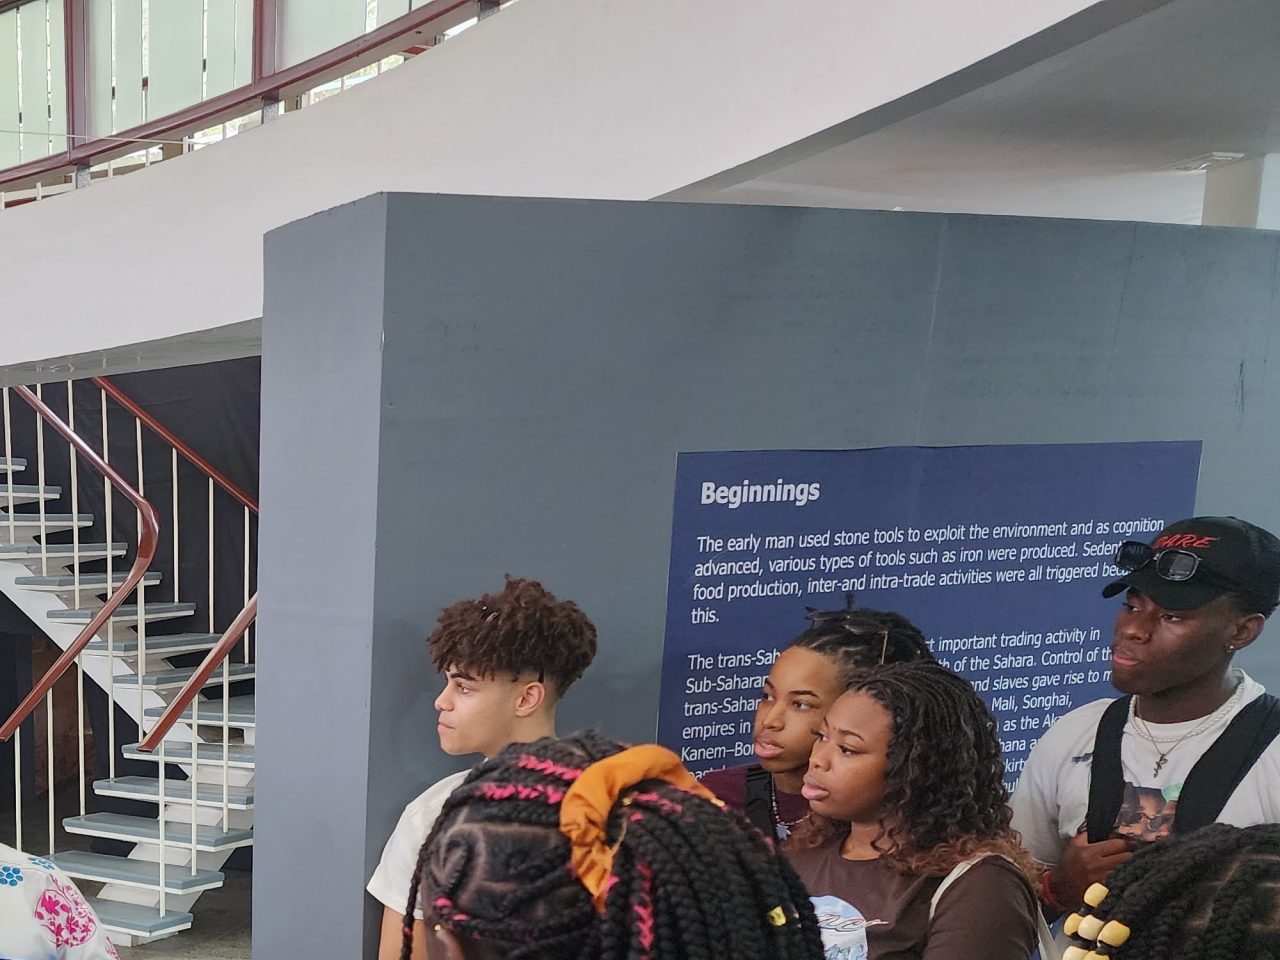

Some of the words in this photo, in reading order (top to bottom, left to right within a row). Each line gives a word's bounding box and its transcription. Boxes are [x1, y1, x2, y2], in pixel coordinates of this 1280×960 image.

[700, 478, 821, 509] Beginnings
[696, 535, 723, 552] The
[727, 533, 761, 553] early
[765, 535, 794, 550] man
[799, 530, 831, 548] used
[833, 529, 870, 546] stone
[873, 526, 904, 544] tools
[908, 526, 920, 542] to
[923, 523, 967, 544] exploit
[969, 522, 990, 540] the
[992, 520, 1068, 539] environment
[1070, 518, 1095, 536] and
[1096, 521, 1111, 535] as
[1112, 516, 1165, 536] cognition
[694, 557, 764, 577] advanced,
[768, 555, 816, 573] various
[819, 554, 855, 574] types
[858, 550, 874, 568] of
[875, 549, 906, 567] tools
[909, 547, 939, 564] such
[941, 549, 957, 563] as
[959, 545, 984, 562] iron
[987, 546, 1018, 562] were
[1020, 542, 1078, 563] produced.
[693, 583, 724, 601] food
[727, 580, 803, 601] production,
[807, 574, 867, 594] inter-and
[869, 570, 936, 590] intra-trade
[938, 567, 992, 586] activities
[996, 569, 1026, 583] were
[1028, 565, 1043, 581] all
[1045, 562, 1100, 583] triggered
[691, 606, 720, 624] this.
[687, 654, 714, 671] The
[718, 648, 781, 669] trans-Sah
[938, 633, 997, 654] important
[1000, 630, 1042, 649] trading
[1045, 627, 1088, 645] activity
[1089, 626, 1101, 642] in
[953, 656, 968, 672] of
[969, 655, 990, 671] the
[992, 652, 1037, 670] Sahara.
[1041, 648, 1084, 667] Control
[1086, 646, 1100, 662] of
[1101, 645, 1113, 661] th
[684, 697, 762, 716] trans-Sahar
[992, 674, 1029, 691] slaves
[1032, 675, 1061, 691] gave
[1063, 670, 1085, 685] rise
[1087, 669, 1101, 683] to
[682, 721, 735, 741] empires
[739, 718, 751, 735] in
[991, 696, 1019, 713] Mali,
[1022, 692, 1073, 712] Songhai,
[1003, 719, 1018, 732] as
[1020, 714, 1040, 730] the
[1042, 712, 1061, 728] Ak
[998, 737, 1027, 753] hana
